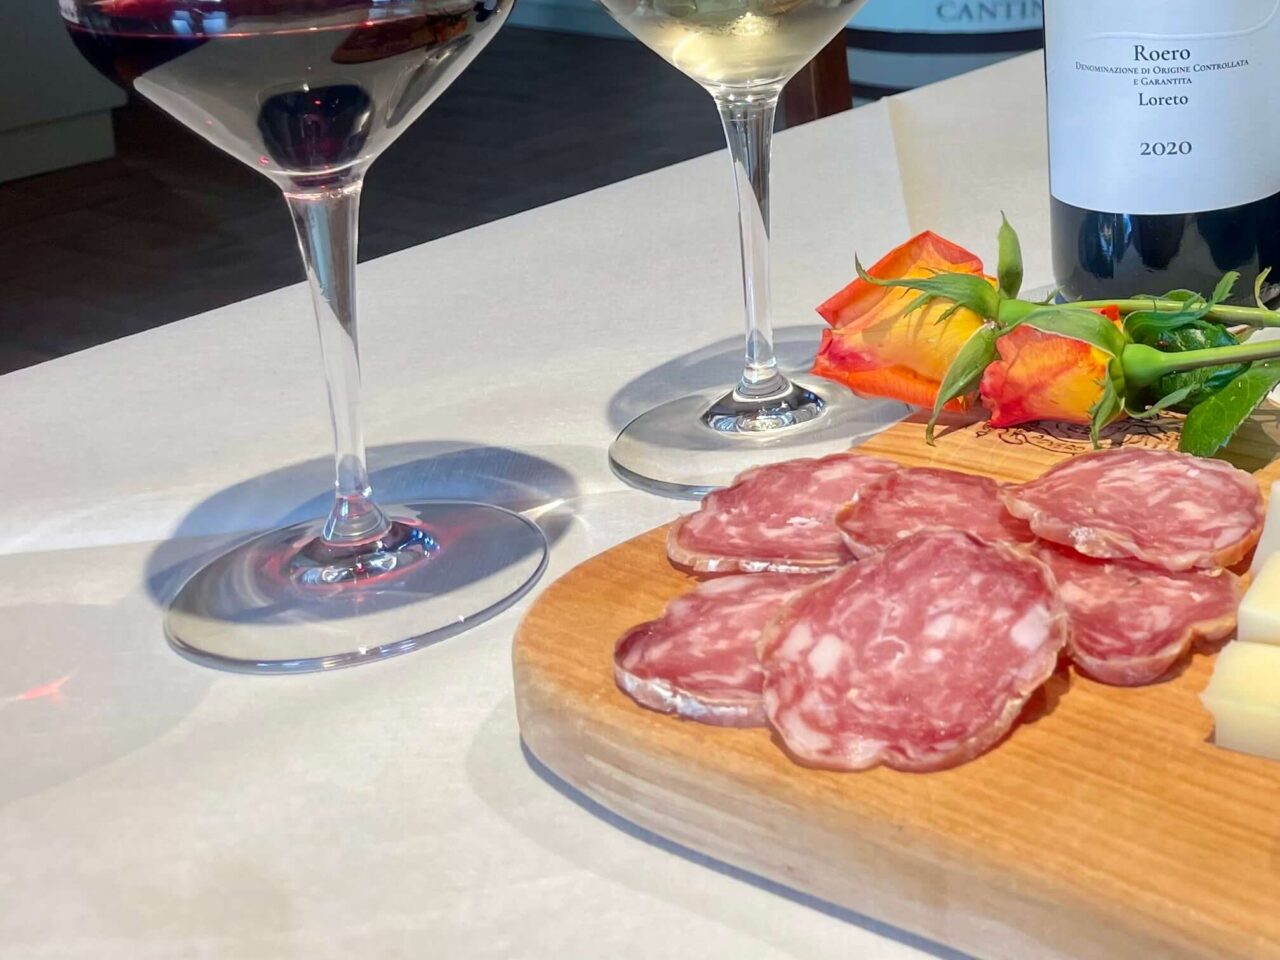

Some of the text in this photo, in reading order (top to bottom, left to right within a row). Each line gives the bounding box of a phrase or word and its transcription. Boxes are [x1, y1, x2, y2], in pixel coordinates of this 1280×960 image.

[1133, 44, 1191, 62] Roero
[1140, 76, 1193, 86] GARANTITA
[1138, 92, 1189, 107] Loreto
[1139, 140, 1193, 157] 2020
